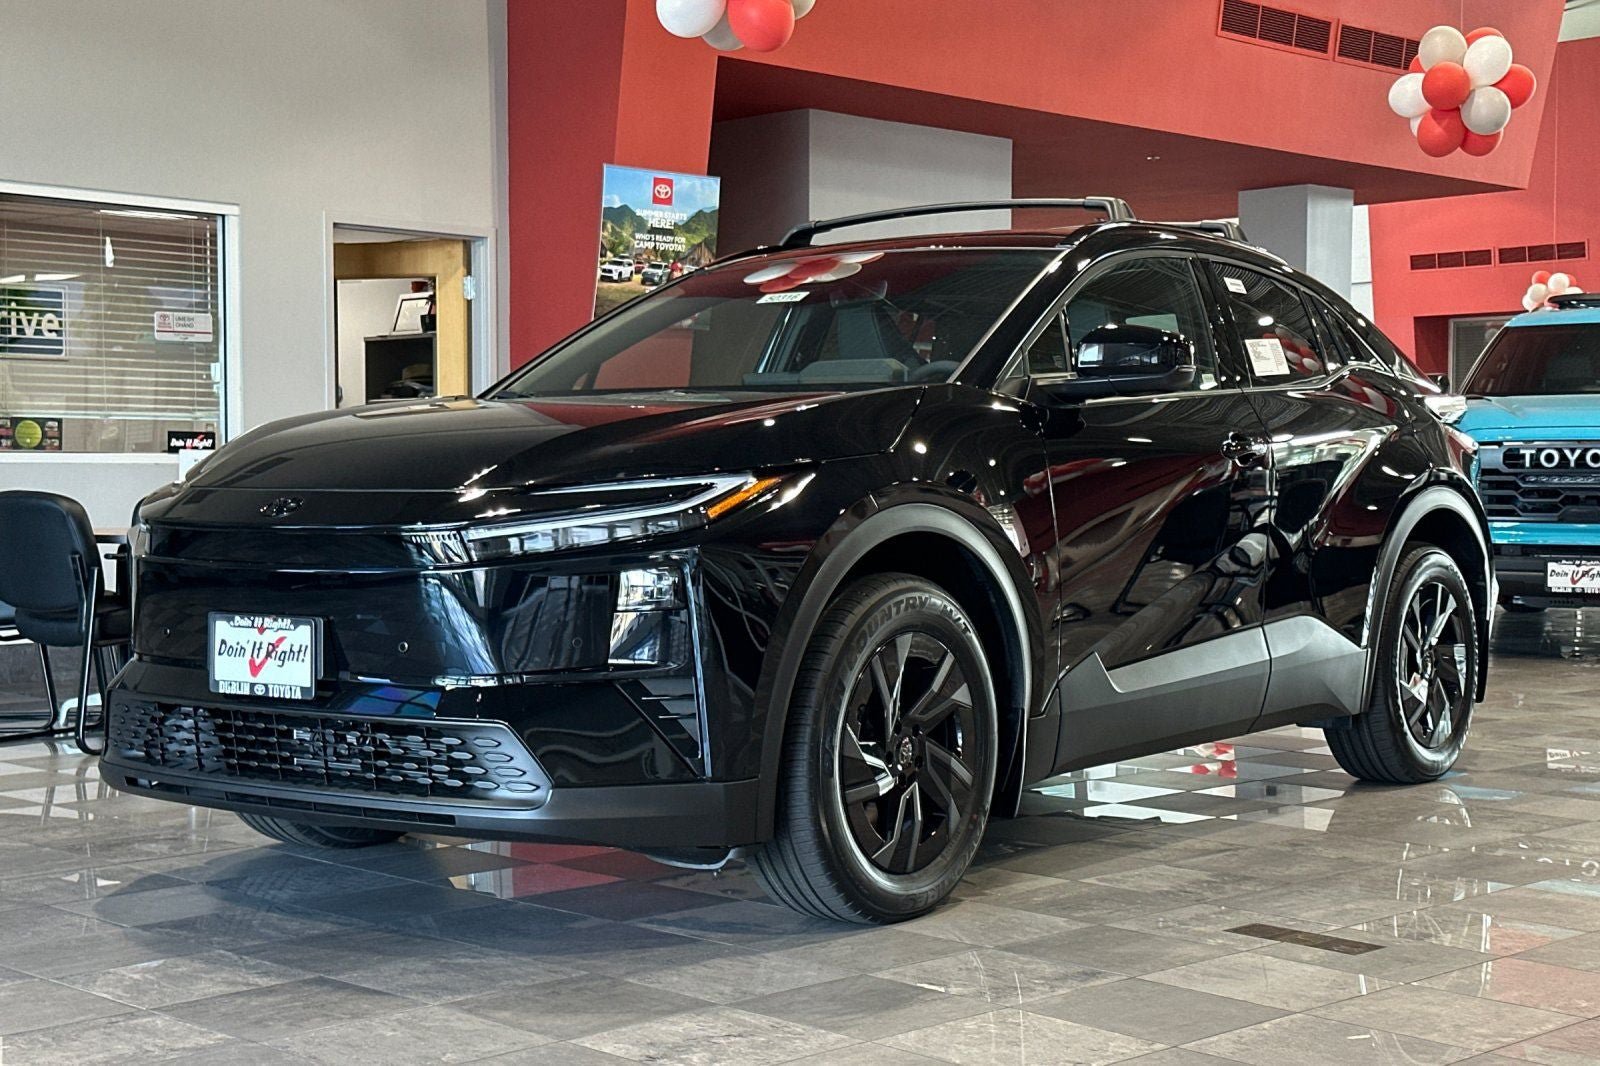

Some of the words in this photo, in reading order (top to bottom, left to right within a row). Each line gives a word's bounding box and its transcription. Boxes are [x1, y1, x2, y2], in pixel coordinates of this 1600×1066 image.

[636, 208, 664, 219] SUMMER
[664, 211, 688, 220] STARTS
[648, 218, 675, 229] HERE!
[635, 233, 655, 241] WHO'S
[655, 234, 675, 243] READY
[635, 240, 655, 249] CAMP
[655, 242, 686, 252] TOYOTA?
[1519, 448, 1600, 468] TOYO
[218, 639, 250, 658] Doin'
[251, 641, 263, 659] It
[265, 642, 309, 668] Right!
[219, 681, 251, 695] DUBLIN
[268, 684, 302, 699] TOYOTA
